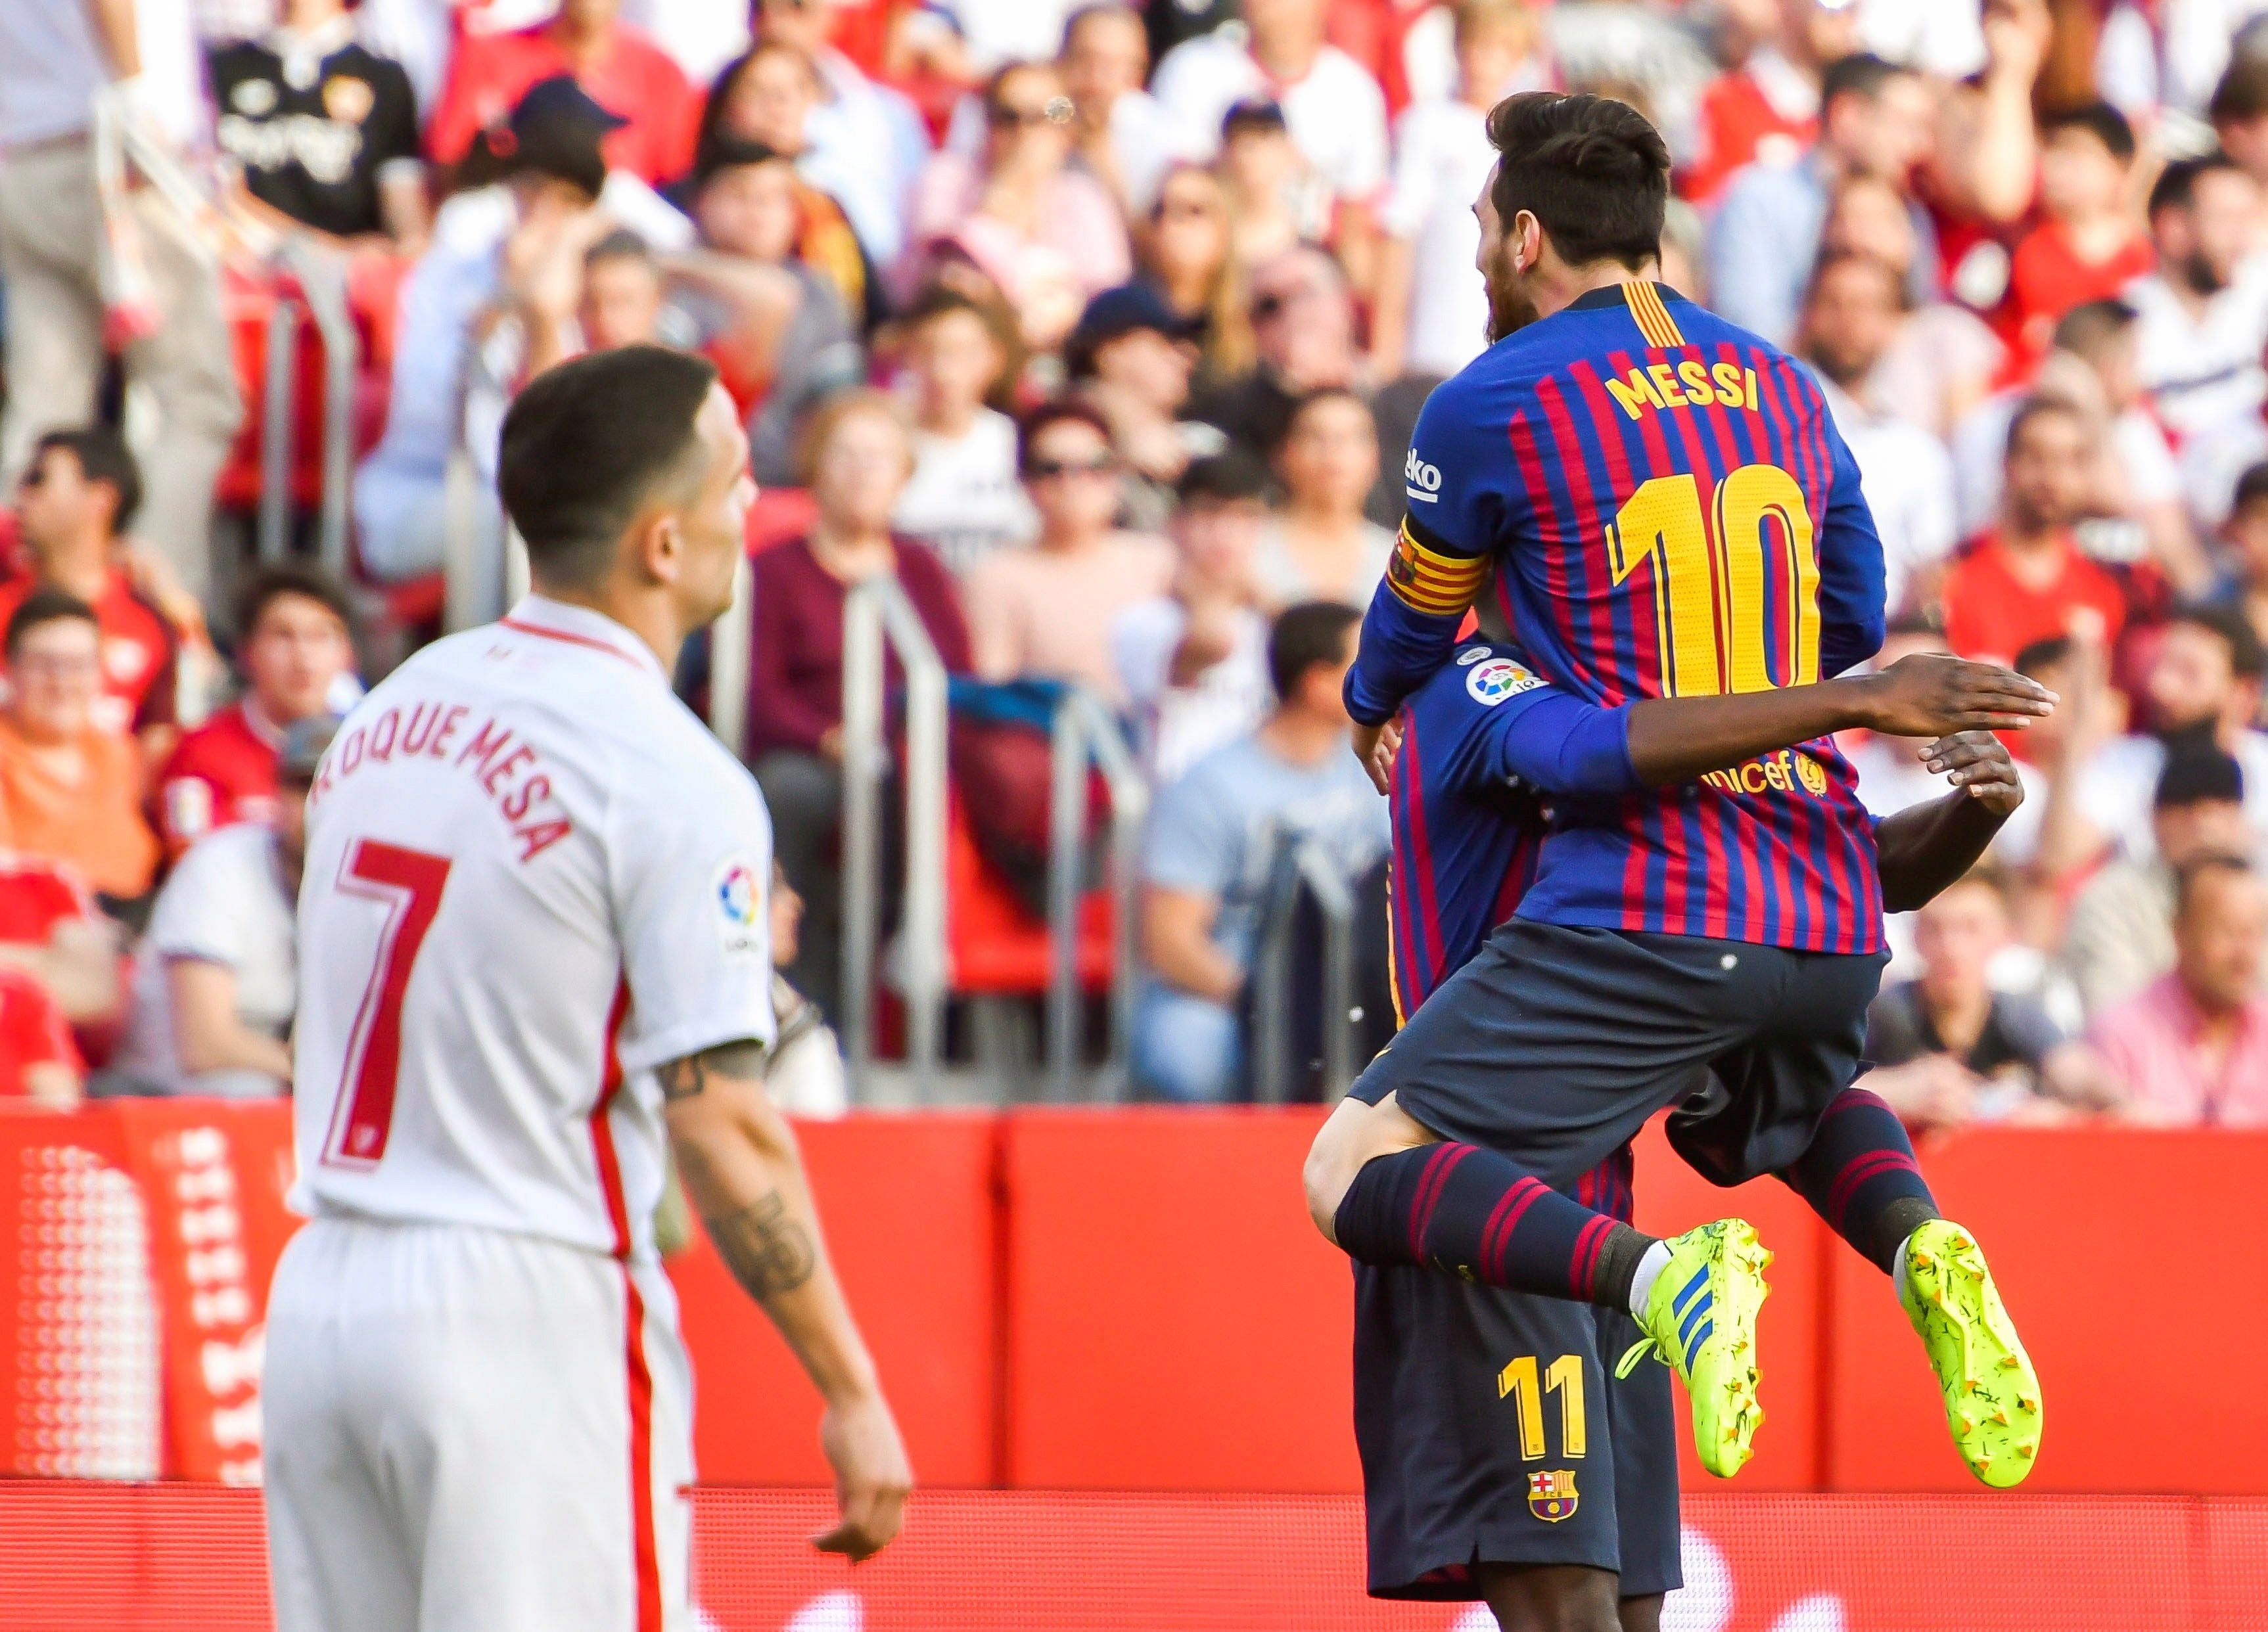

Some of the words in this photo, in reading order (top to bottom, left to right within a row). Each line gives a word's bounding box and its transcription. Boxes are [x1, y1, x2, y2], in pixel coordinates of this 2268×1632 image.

[1604, 361, 1759, 420] MESSI
[1604, 463, 1821, 699] 10
[455, 717, 572, 865] MESA
[1701, 750, 1795, 794] nicef
[319, 836, 453, 1173] 7
[1498, 1354, 1586, 1461] 11
